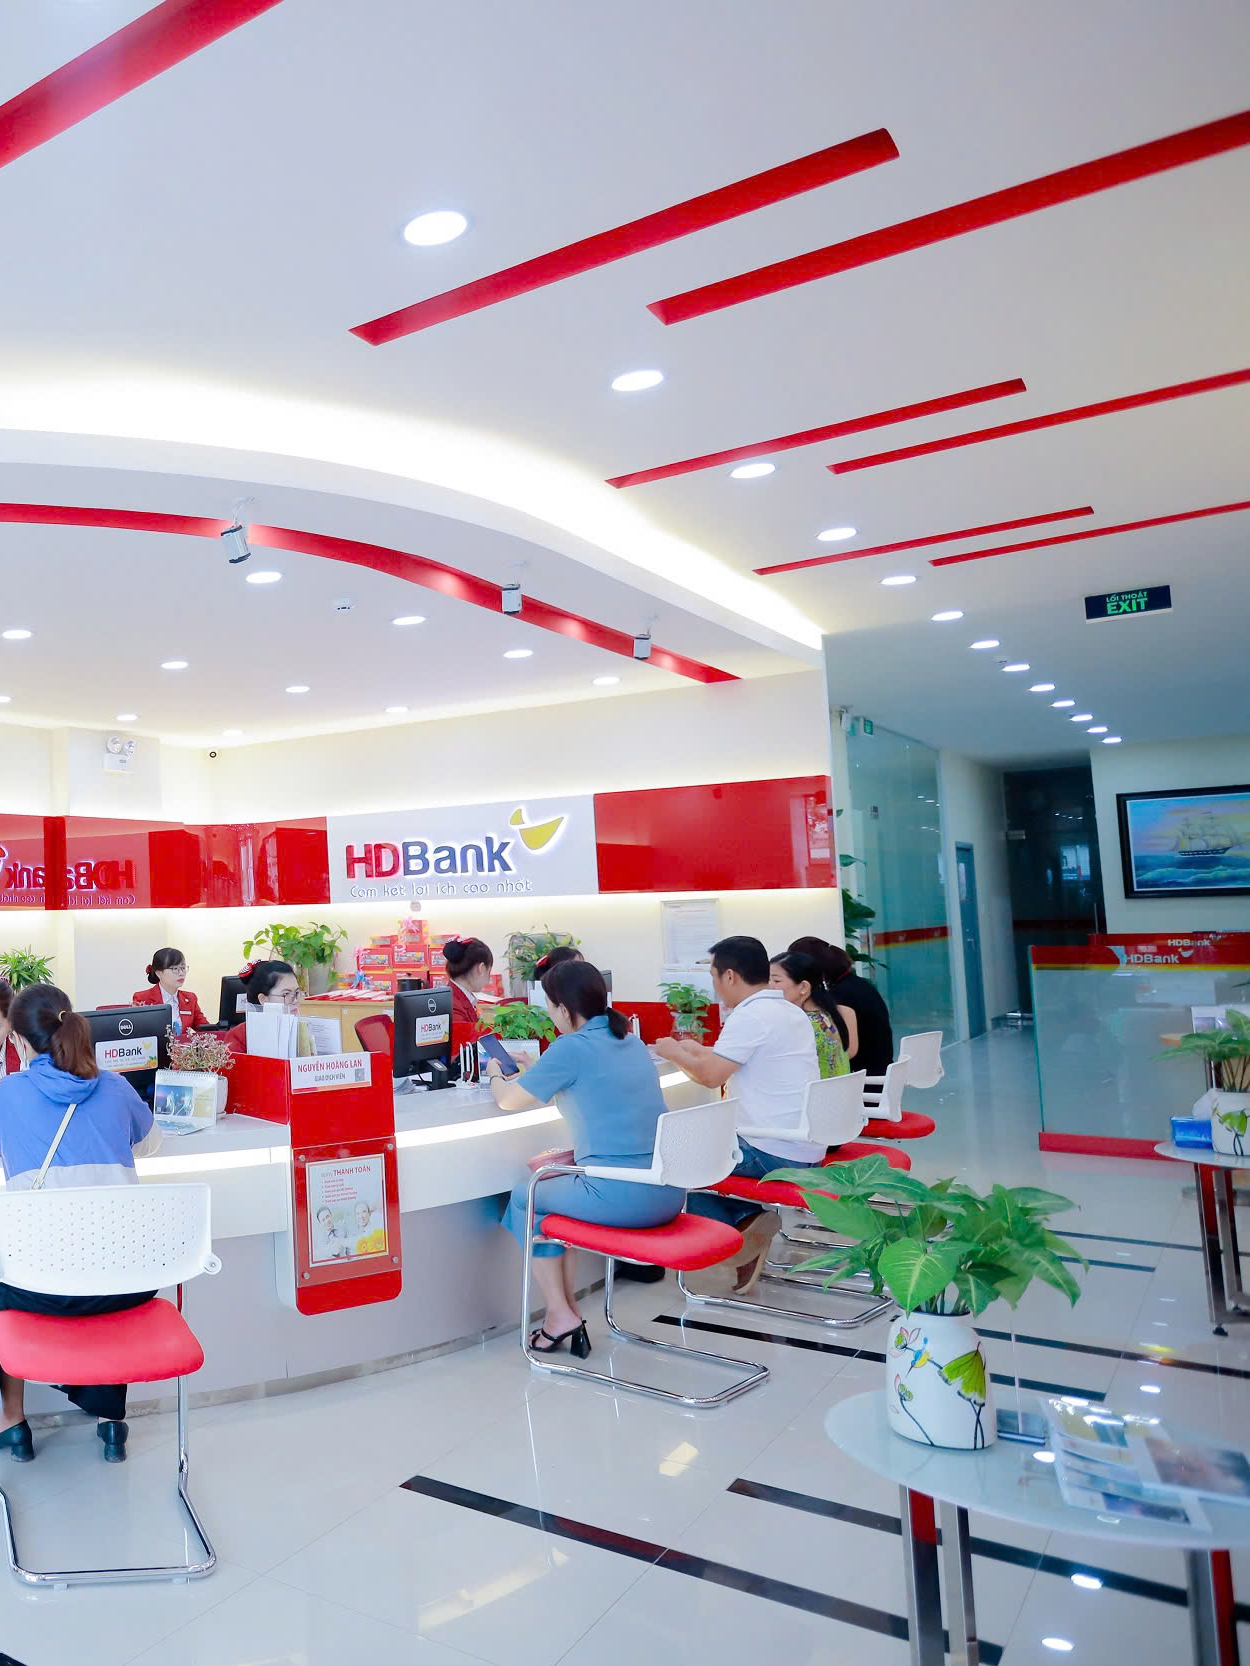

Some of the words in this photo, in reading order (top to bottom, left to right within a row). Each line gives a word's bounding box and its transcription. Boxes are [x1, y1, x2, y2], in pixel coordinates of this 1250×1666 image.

[1106, 598, 1148, 614] EXIT
[345, 836, 513, 879] HDBank
[350, 885, 378, 898] Cam
[383, 883, 406, 897] kết
[463, 883, 489, 894] cao
[497, 878, 533, 893] nhất
[1167, 938, 1210, 946] HDBank
[1127, 953, 1180, 963] HDBank
[104, 1046, 142, 1059] HDBank
[350, 1059, 363, 1068] LAN
[333, 1168, 354, 1176] THANH
